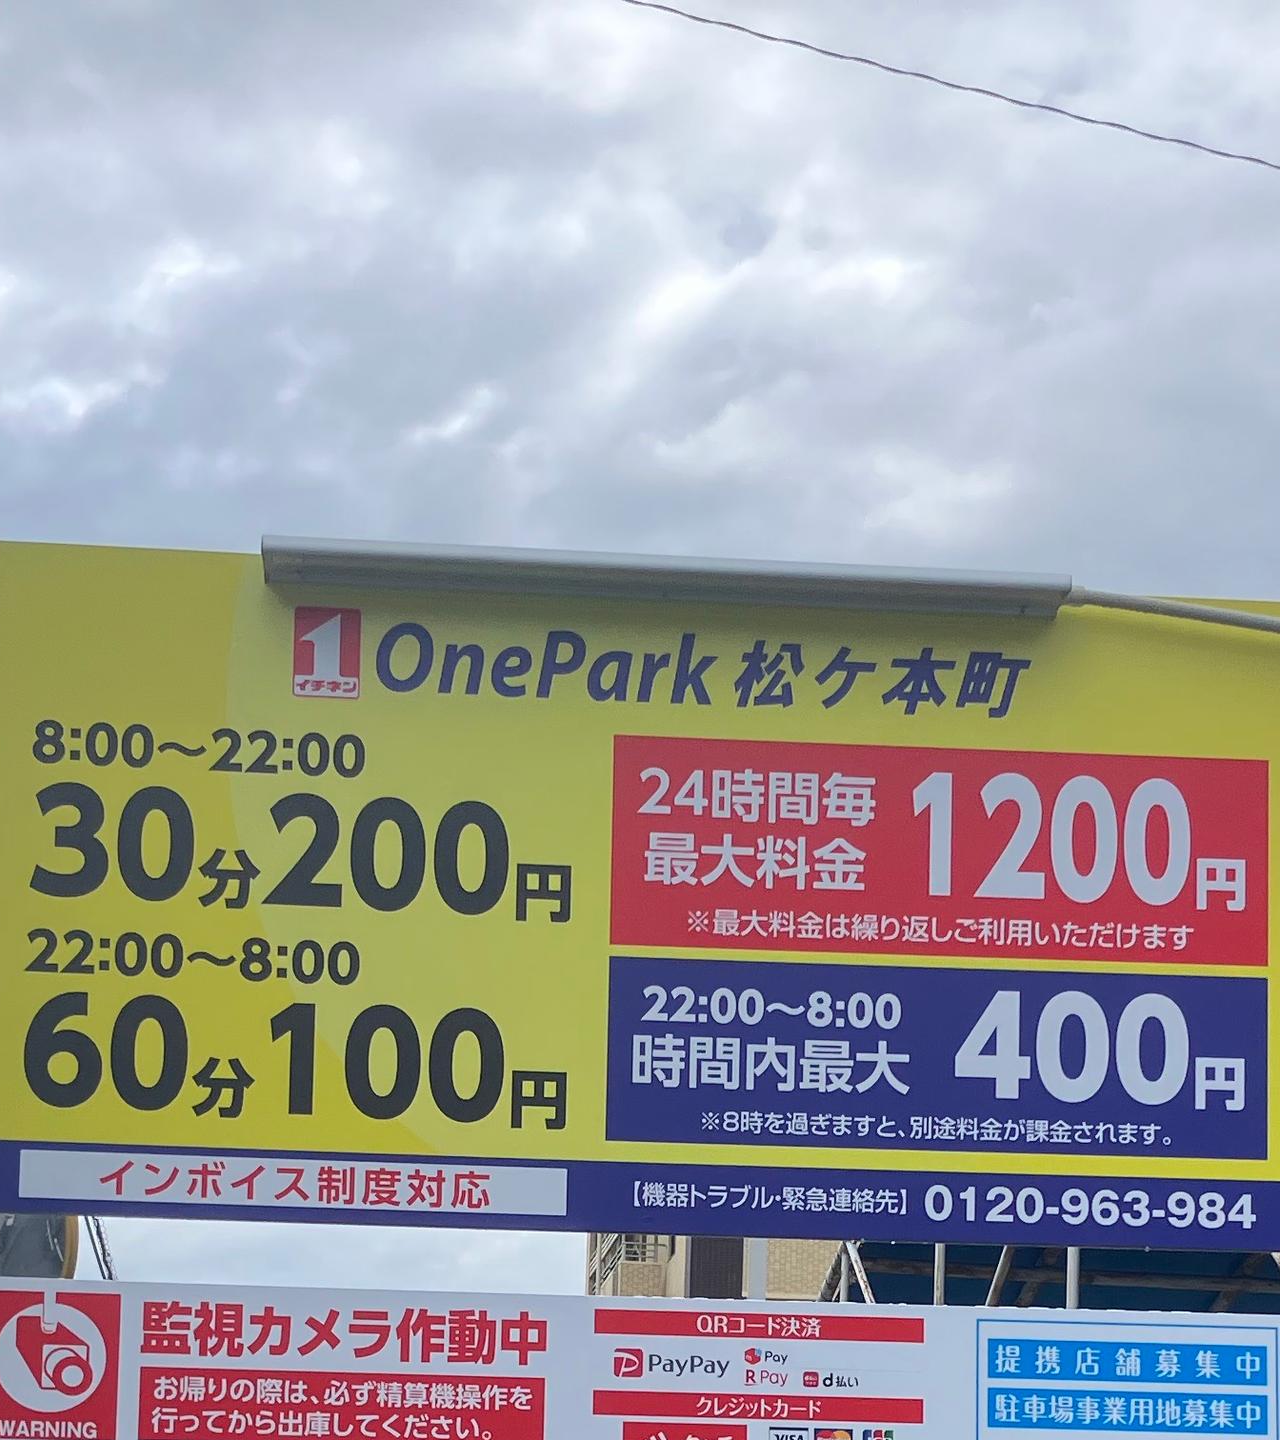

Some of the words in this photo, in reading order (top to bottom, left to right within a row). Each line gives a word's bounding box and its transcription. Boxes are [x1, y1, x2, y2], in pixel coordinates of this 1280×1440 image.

[376, 622, 719, 706] OnePark
[295, 677, 358, 695] イチネン
[636, 766, 877, 827] 24時間毎
[913, 771, 1248, 911] 1200円
[643, 832, 868, 892] 最大料金
[687, 909, 1193, 953] ※最大料金は繰り返しご利用いただけます
[631, 1033, 911, 1095] 時間内最大
[954, 990, 1246, 1113] 400円
[700, 1109, 1174, 1147] ※8時を過ぎますと、別途料金が課金されます。
[99, 1160, 492, 1210] インボイス制度対応
[924, 1184, 1257, 1230] 0120-963-984
[139, 1301, 548, 1366] 監視カメラ作動中
[696, 1315, 822, 1338] QRコード決済
[648, 1353, 730, 1378] PayPay
[765, 1351, 788, 1365] Pay
[995, 1344, 1261, 1380] 提携店舗募集中
[153, 1376, 532, 1411] お帰りの際は、必ず精算機操作を
[823, 1373, 859, 1387] d払い
[696, 1397, 821, 1420] クレジットカード
[995, 1393, 1261, 1429] 駐車場事業用地募集中
